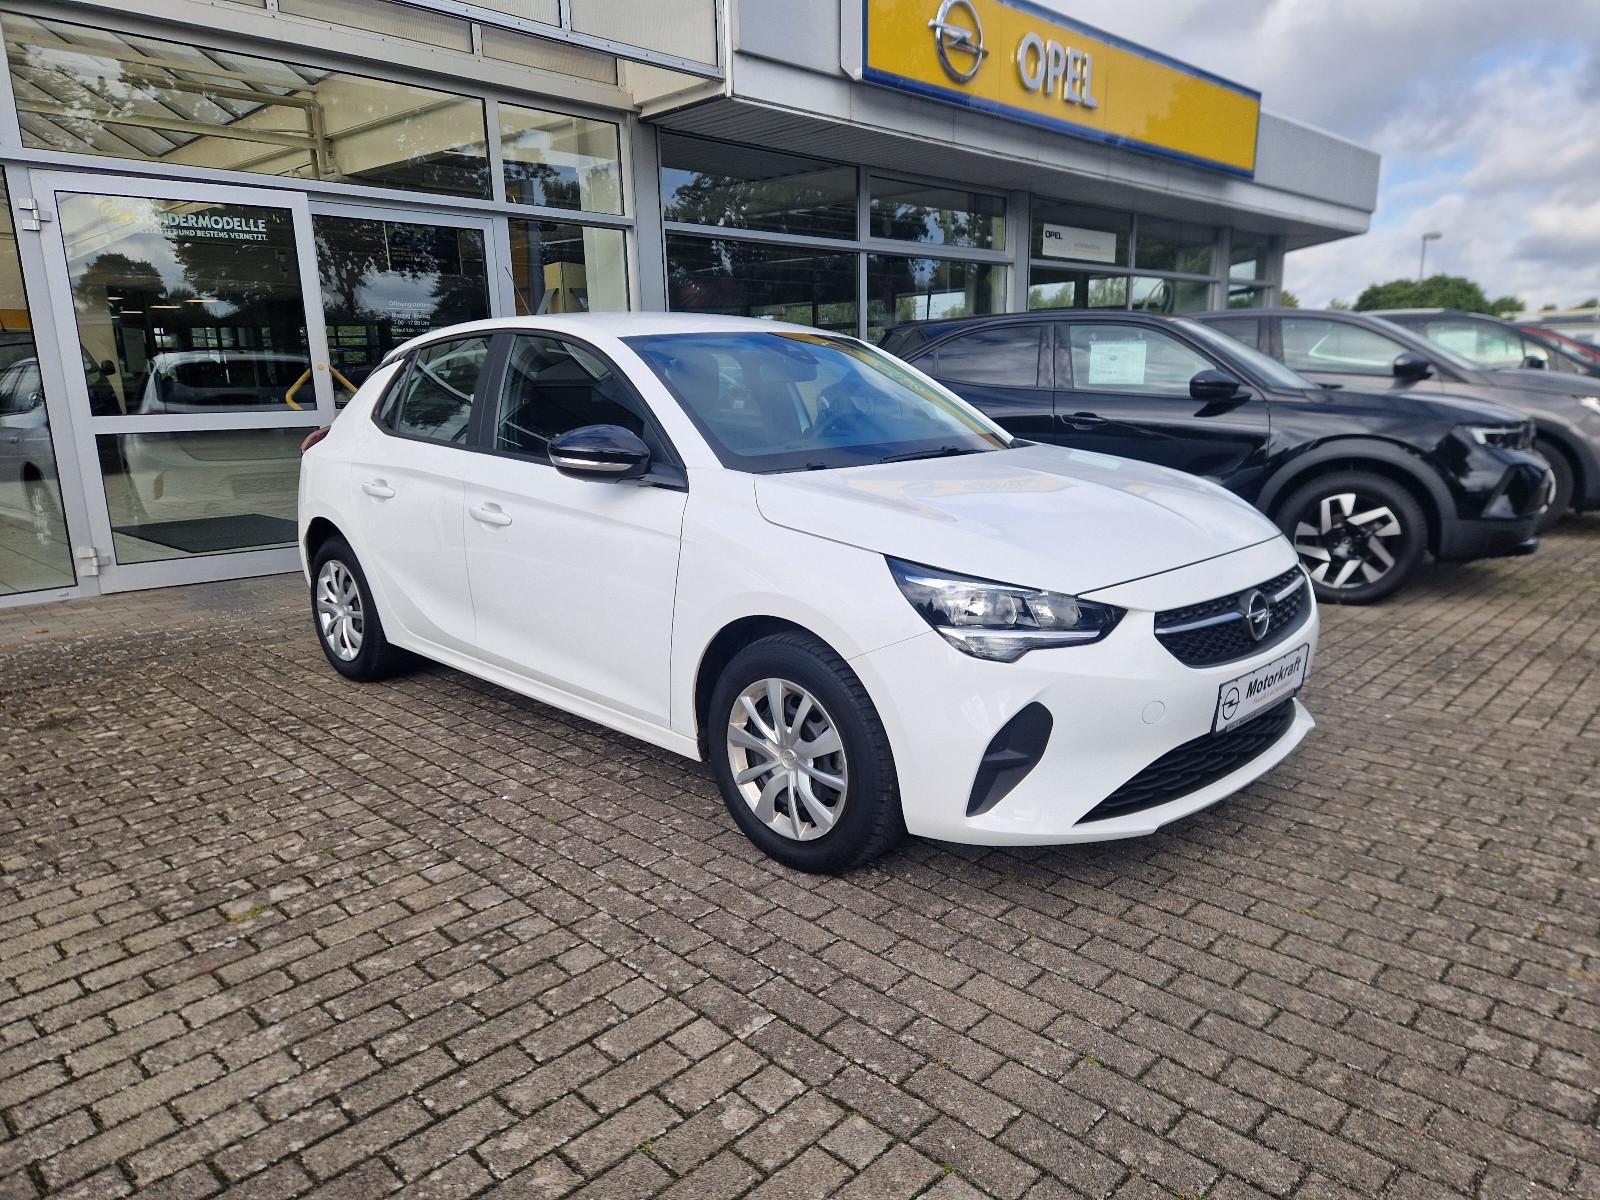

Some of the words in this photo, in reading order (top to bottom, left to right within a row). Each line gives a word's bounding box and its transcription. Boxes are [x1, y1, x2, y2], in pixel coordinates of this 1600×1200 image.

[1016, 31, 1098, 108] OPEL
[140, 210, 267, 232] NDERMODELLE
[197, 229, 229, 239] BESTENS
[230, 232, 269, 241] VERNETZT.
[1045, 230, 1062, 240] OPEL
[1246, 657, 1302, 700] Motorkraft
